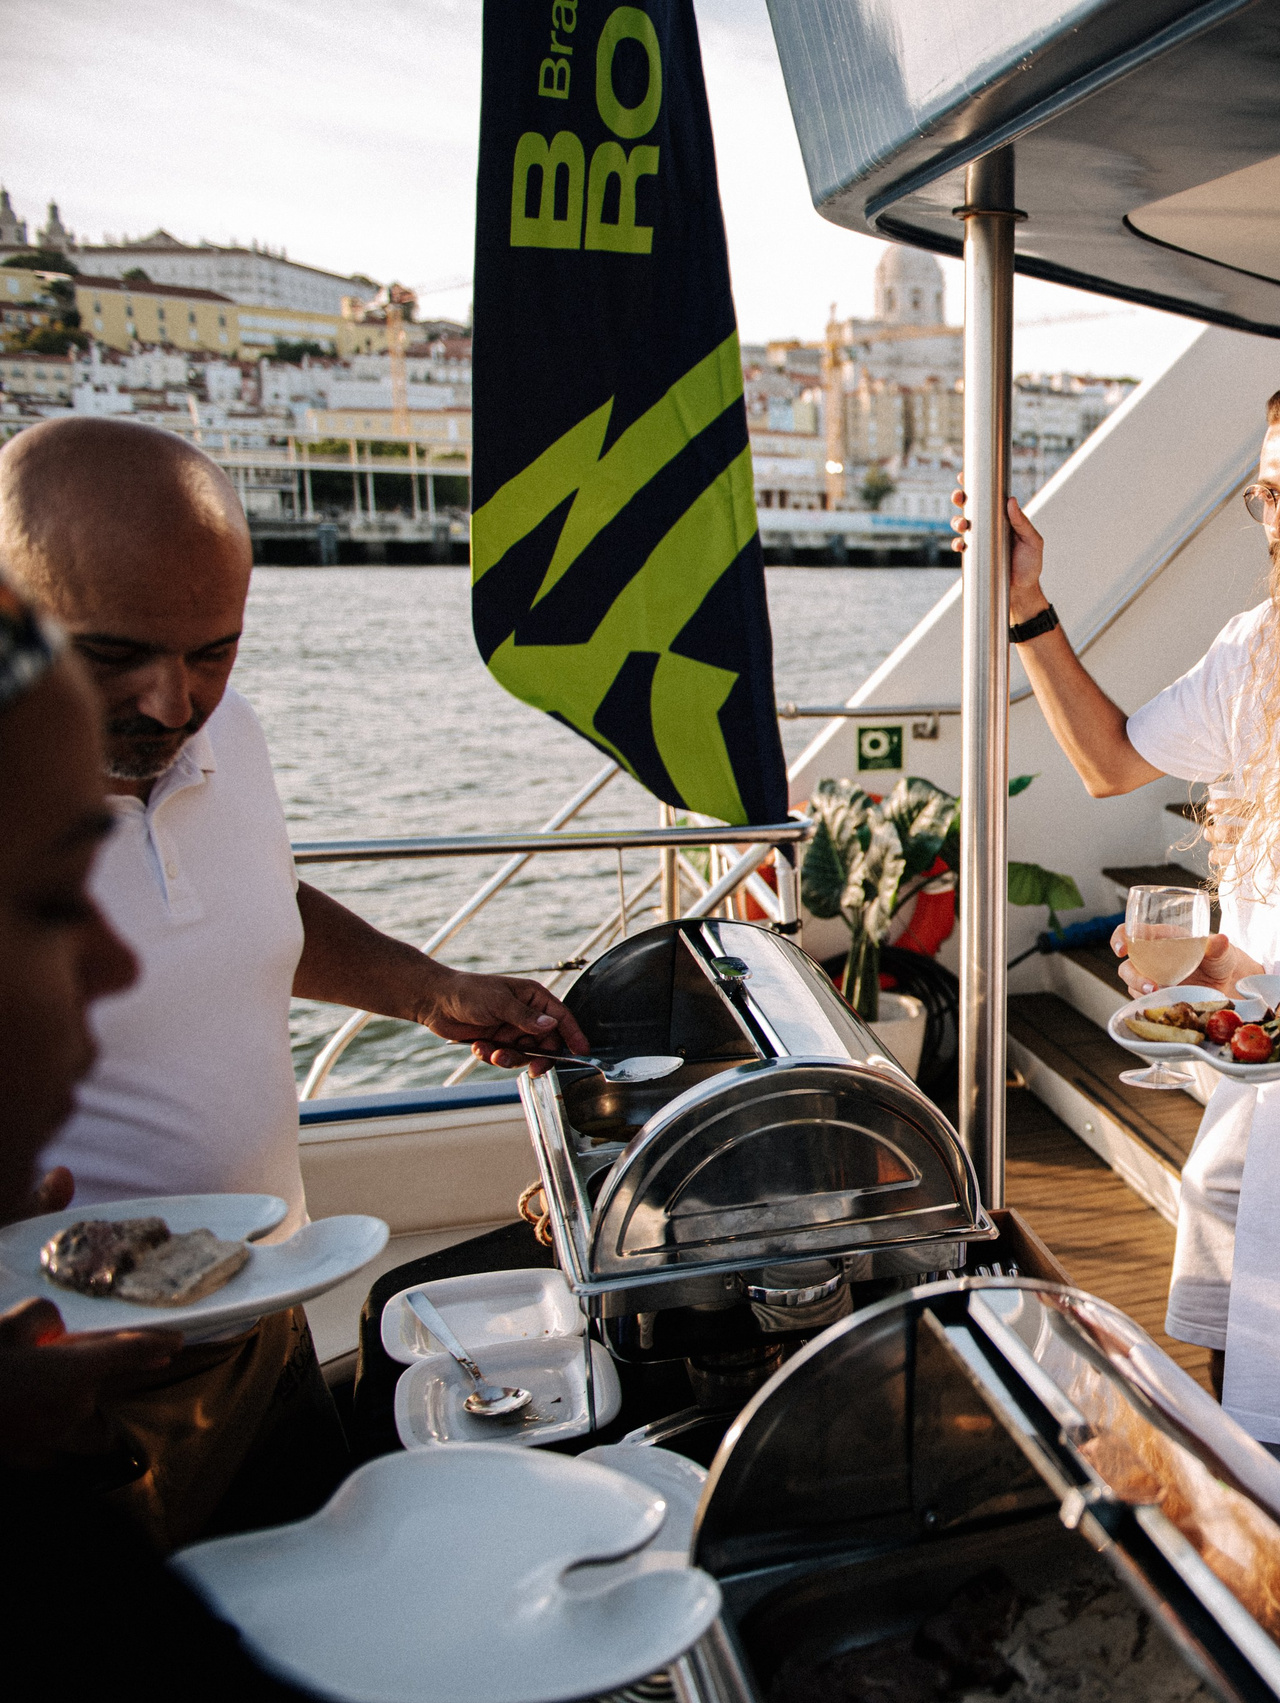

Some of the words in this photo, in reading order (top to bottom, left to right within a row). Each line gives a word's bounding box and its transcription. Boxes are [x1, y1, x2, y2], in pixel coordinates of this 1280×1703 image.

[538, 0, 579, 100] Bra
[584, 5, 662, 254] RO
[509, 130, 585, 250] B
